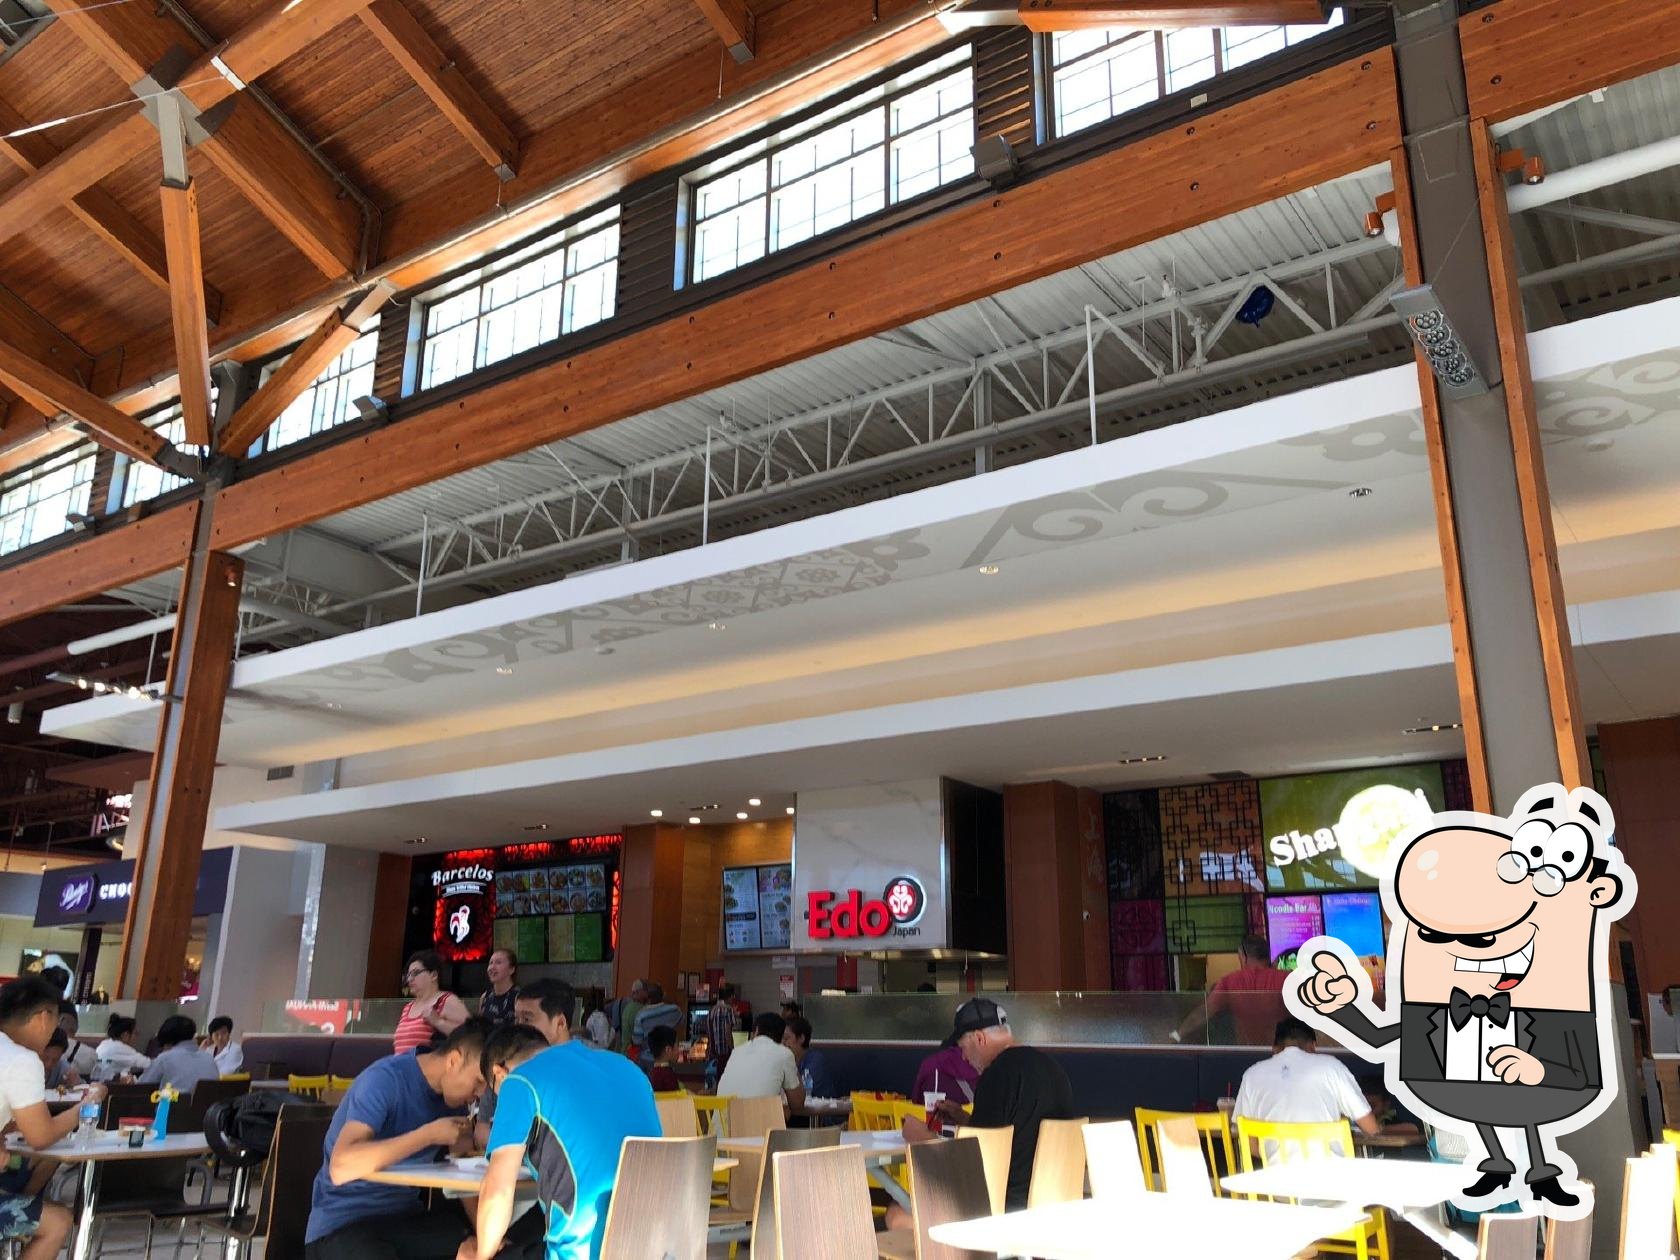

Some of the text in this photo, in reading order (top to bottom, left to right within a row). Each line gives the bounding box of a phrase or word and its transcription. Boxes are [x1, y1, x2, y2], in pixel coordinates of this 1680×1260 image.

[431, 864, 494, 886] Barcelos
[808, 888, 891, 938] Edo
[893, 927, 921, 938] Japan
